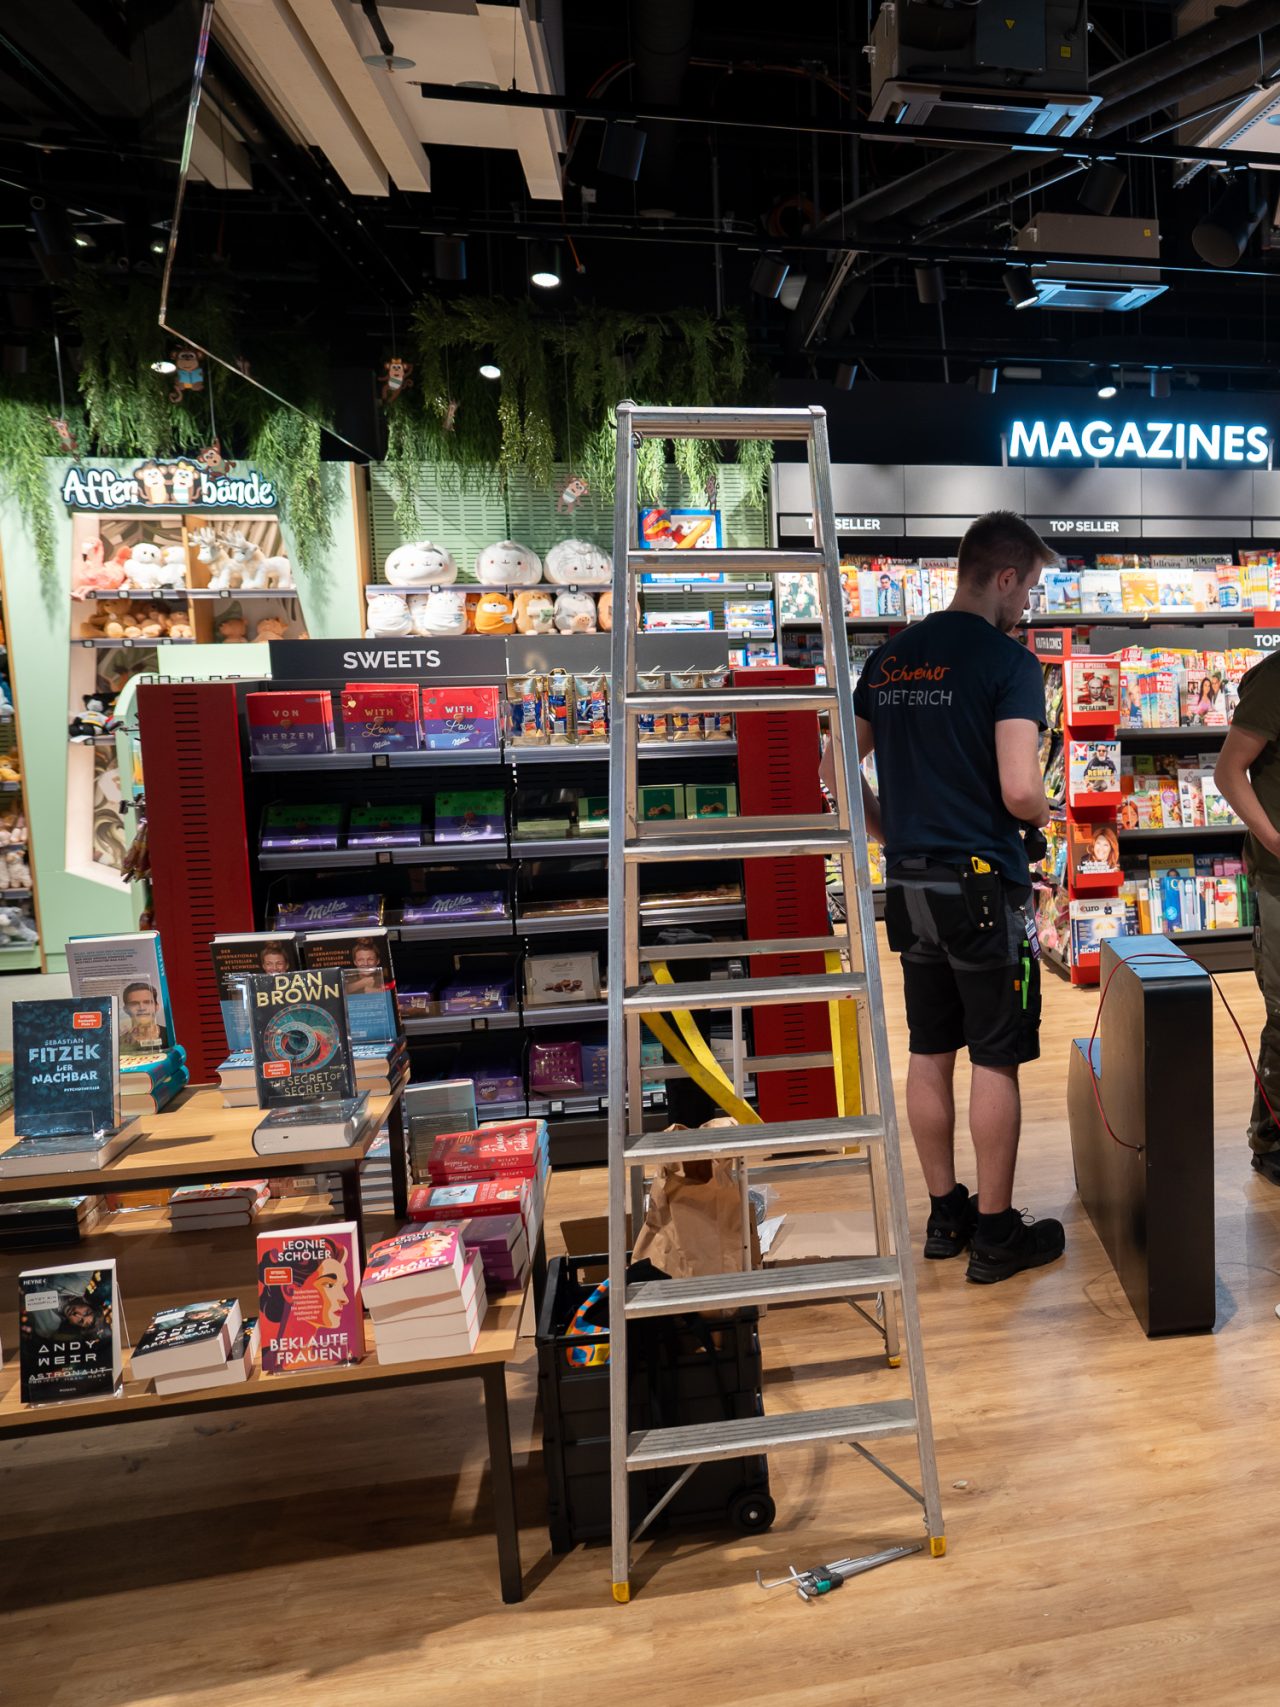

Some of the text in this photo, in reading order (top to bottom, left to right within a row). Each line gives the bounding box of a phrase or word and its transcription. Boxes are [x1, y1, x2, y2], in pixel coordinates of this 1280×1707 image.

[1009, 421, 1269, 463] MAGAZINES
[63, 468, 139, 506] Affen
[834, 518, 881, 530] SELLER
[1050, 521, 1119, 532] TOP SELLER
[1254, 635, 1280, 646] TOP
[343, 650, 441, 669] SWEETS
[868, 656, 951, 688] Schreiner
[879, 690, 953, 706] DIETERICH
[272, 709, 300, 717] VON
[364, 707, 394, 717] WITH
[445, 705, 473, 714] WITH
[361, 722, 397, 737] Love
[442, 719, 476, 734] Love
[262, 732, 315, 741] HERZEN
[304, 900, 349, 921] Milka
[431, 895, 474, 913] Milka
[275, 972, 323, 991] DAN
[256, 983, 340, 1007] BROWN
[44, 1038, 84, 1046] SEBASTIAN
[28, 1044, 101, 1063] FITZEK
[57, 1064, 73, 1072] DER
[32, 1070, 98, 1084] NACHBAR
[287, 1072, 329, 1086] SECRET
[330, 1073, 341, 1081] OF
[285, 1082, 333, 1096] SECRETS
[282, 1239, 326, 1251] LEONIE
[277, 1249, 331, 1262] SCHÖLER
[38, 1340, 97, 1353] ANDY
[270, 1332, 349, 1352] BEKLAUTE
[38, 1353, 97, 1367] WEIR
[276, 1347, 342, 1365] FRAUEN
[29, 1367, 107, 1381] ASTRONAUT
